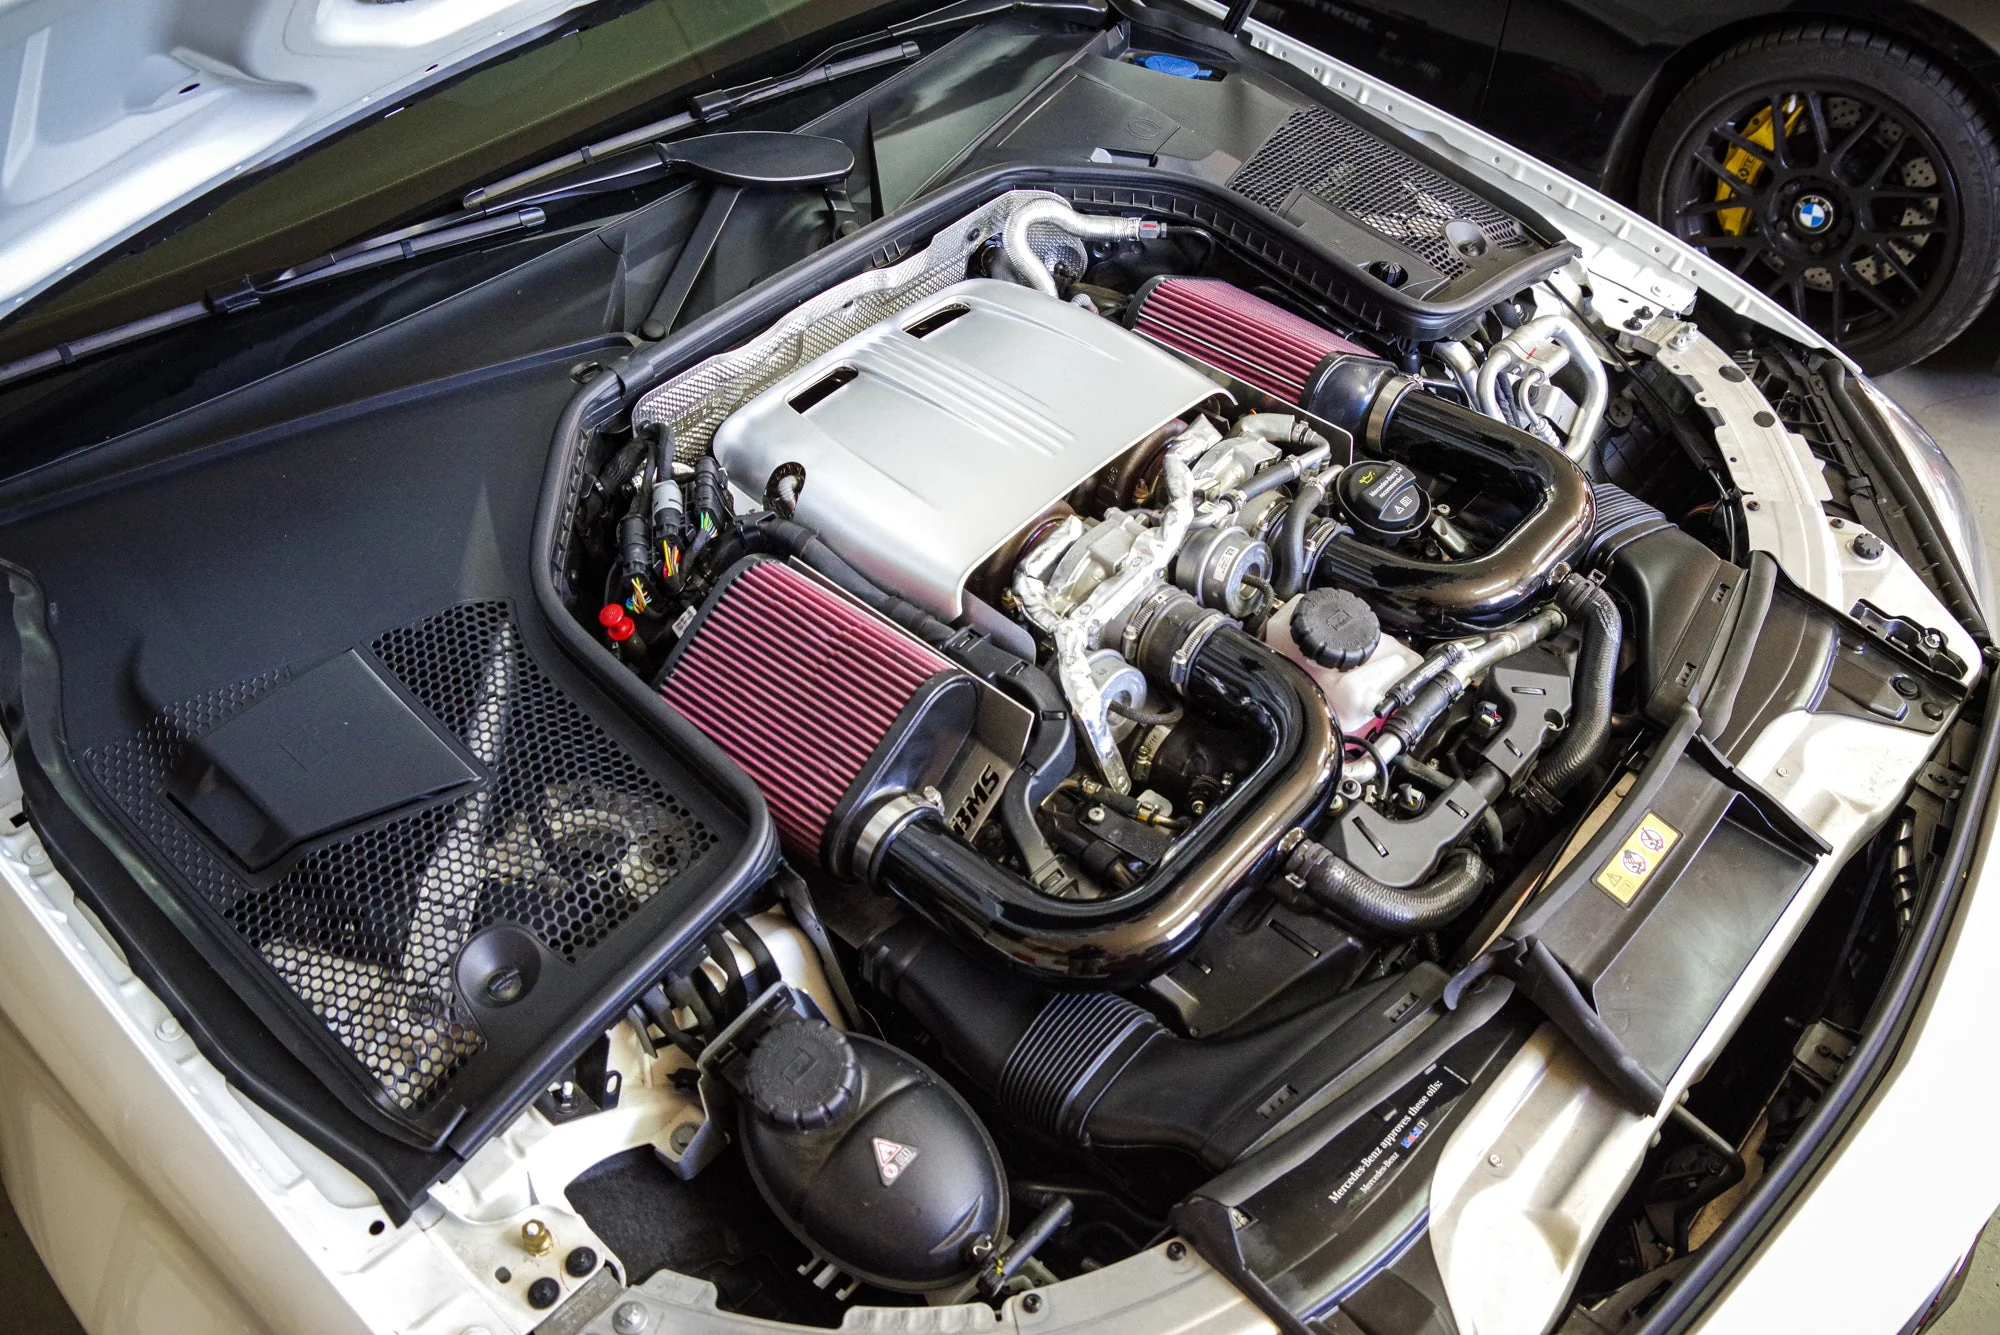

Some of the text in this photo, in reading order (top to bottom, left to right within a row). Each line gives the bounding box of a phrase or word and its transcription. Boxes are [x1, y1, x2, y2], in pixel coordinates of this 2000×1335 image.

[1369, 471, 1398, 498] Mercedes-Benz
[1328, 1080, 1443, 1204] Mercedes-Benz approves these oils:
[1360, 1151, 1400, 1194] Mercedes-Benz
[1400, 1125, 1423, 1149] Mobil
